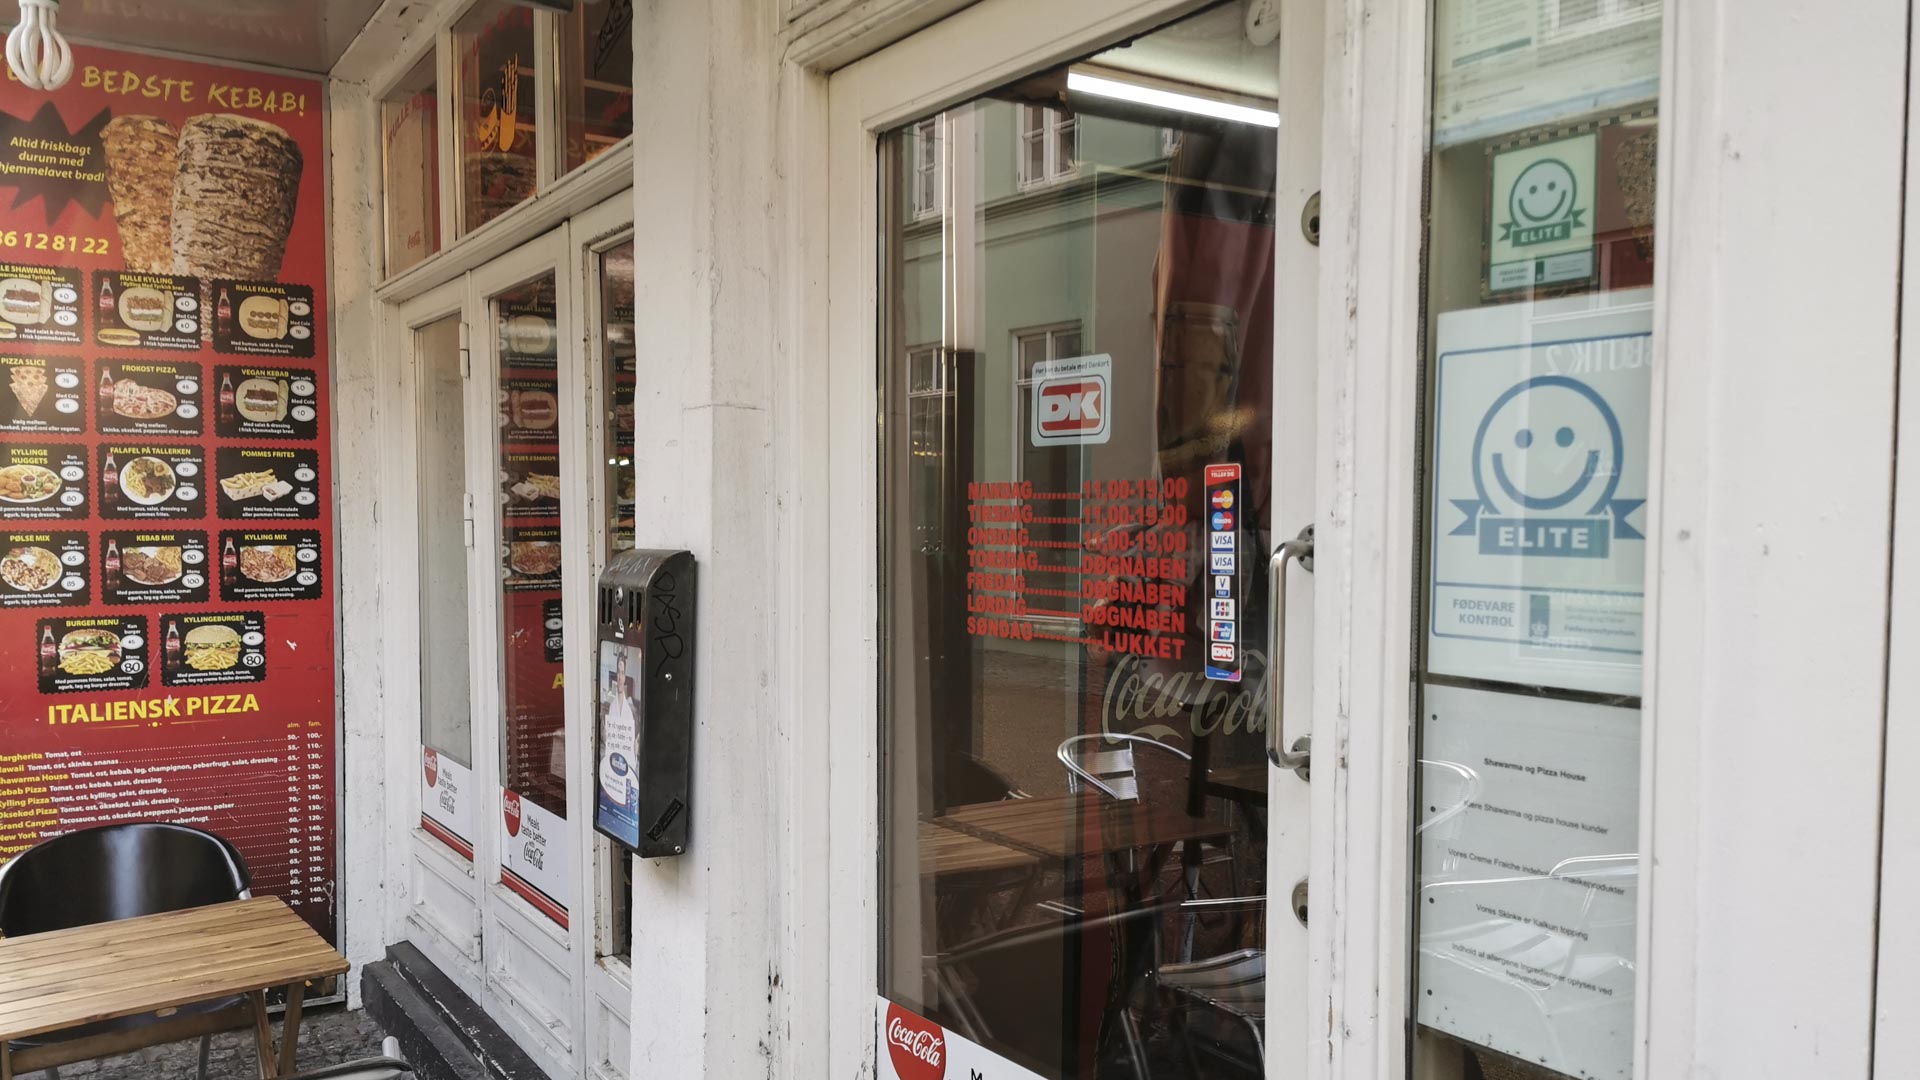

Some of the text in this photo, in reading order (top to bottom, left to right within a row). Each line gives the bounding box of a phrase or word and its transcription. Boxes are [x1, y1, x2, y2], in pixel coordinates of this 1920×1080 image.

[81, 66, 195, 102] BEDSTE
[208, 82, 305, 117] KEBAB!
[10, 136, 91, 156] Altid friskbagt
[18, 150, 84, 167] durum med
[0, 161, 105, 182] hjemmelavet brød!
[1520, 225, 1562, 243] ELITE
[82, 237, 109, 255] 22
[11, 265, 56, 276] SHAWARMA
[120, 274, 173, 284] RULLE KYLLING
[236, 284, 286, 295] RULLE FALAFEL
[1, 357, 46, 367] PIZZA SLICE
[122, 365, 177, 374] FROKOST PIZZA
[241, 369, 265, 377] VEGAN
[1040, 390, 1100, 422] DK
[141, 446, 151, 454] PÅ
[152, 447, 191, 455] TALLERKEN
[241, 450, 271, 458] POMMES
[968, 481, 1033, 500] MANDAG
[968, 504, 1033, 524] TIRSDAG
[968, 527, 1029, 548] ONSDAG
[1214, 535, 1232, 545] VISA
[1498, 526, 1589, 550] ELITE
[968, 550, 1038, 571] TORSDAG
[1214, 557, 1232, 567] VISA
[967, 572, 1025, 594] FREDAG
[967, 595, 1027, 617] LØRDAG
[1452, 598, 1515, 613] FØDEVARE
[184, 615, 245, 624] KYLLINGEBURGER
[1458, 614, 1515, 629] KONTROL
[967, 617, 1033, 641] SØNDAG
[1103, 631, 1185, 660] LUKKET
[124, 662, 141, 673] 80
[245, 656, 262, 665] 80
[48, 693, 260, 725] ITALIENSK PIZZA
[42, 773, 69, 781] House
[442, 767, 453, 781] Meals
[1484, 757, 1586, 782] Shawarma og Pizza House
[25, 786, 47, 794] Pizza
[133, 777, 162, 785] dressing
[28, 797, 50, 805] Pizza
[151, 797, 179, 805] dressing
[25, 820, 57, 828] Canyon
[527, 813, 540, 831] Meals
[1484, 803, 1522, 818] Shawarma
[1523, 812, 1533, 821] og
[1534, 813, 1554, 826] pizza
[1556, 818, 1580, 830] house
[1581, 822, 1608, 835] kunder
[521, 824, 547, 846] taste better
[1469, 853, 1492, 865] Creme
[1476, 903, 1496, 916] Vores
[1498, 909, 1522, 922] Skinke
[1560, 925, 1588, 941] topping
[1567, 977, 1596, 992] oplyses
[1598, 985, 1612, 996] ved
[888, 1017, 943, 1067] Coca-Cola
